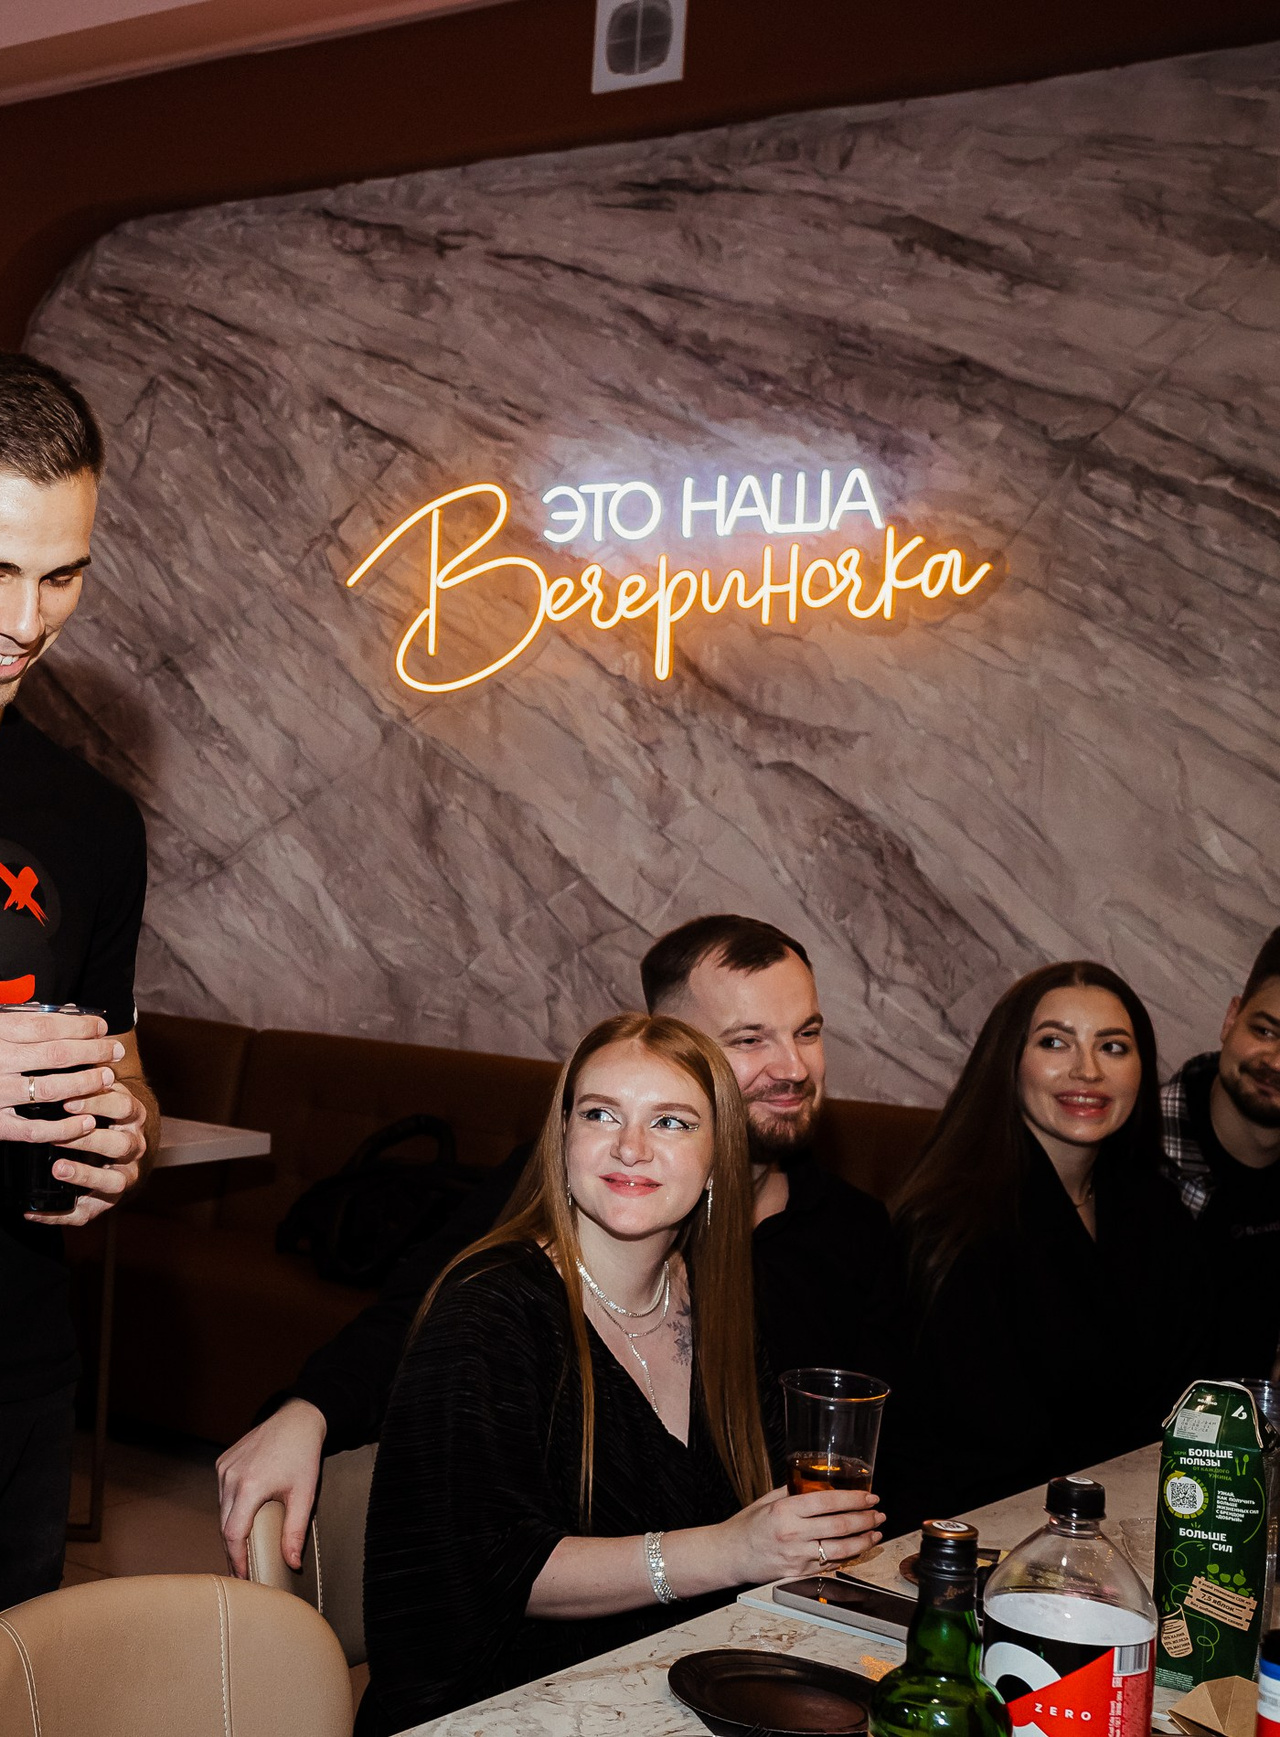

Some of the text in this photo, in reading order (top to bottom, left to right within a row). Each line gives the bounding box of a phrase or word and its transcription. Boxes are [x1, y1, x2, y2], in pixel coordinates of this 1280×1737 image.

[541, 467, 885, 543] ЭТО НАША
[345, 481, 994, 694] Вечериночка
[1188, 1447, 1234, 1459] БОЛЬШЕ
[1179, 1456, 1221, 1467] ПОЛЬЗЫ
[1200, 1466, 1230, 1474] КАЖДОГО
[1208, 1472, 1233, 1482] УЖИНА
[1228, 1497, 1256, 1505] ПОЛУЧИТЬ
[1178, 1527, 1227, 1542] БОЛЬШЕ
[1211, 1542, 1233, 1554] СИЛ
[1200, 1593, 1235, 1613] 7,5 яблок
[1034, 1702, 1092, 1722] ZERO
